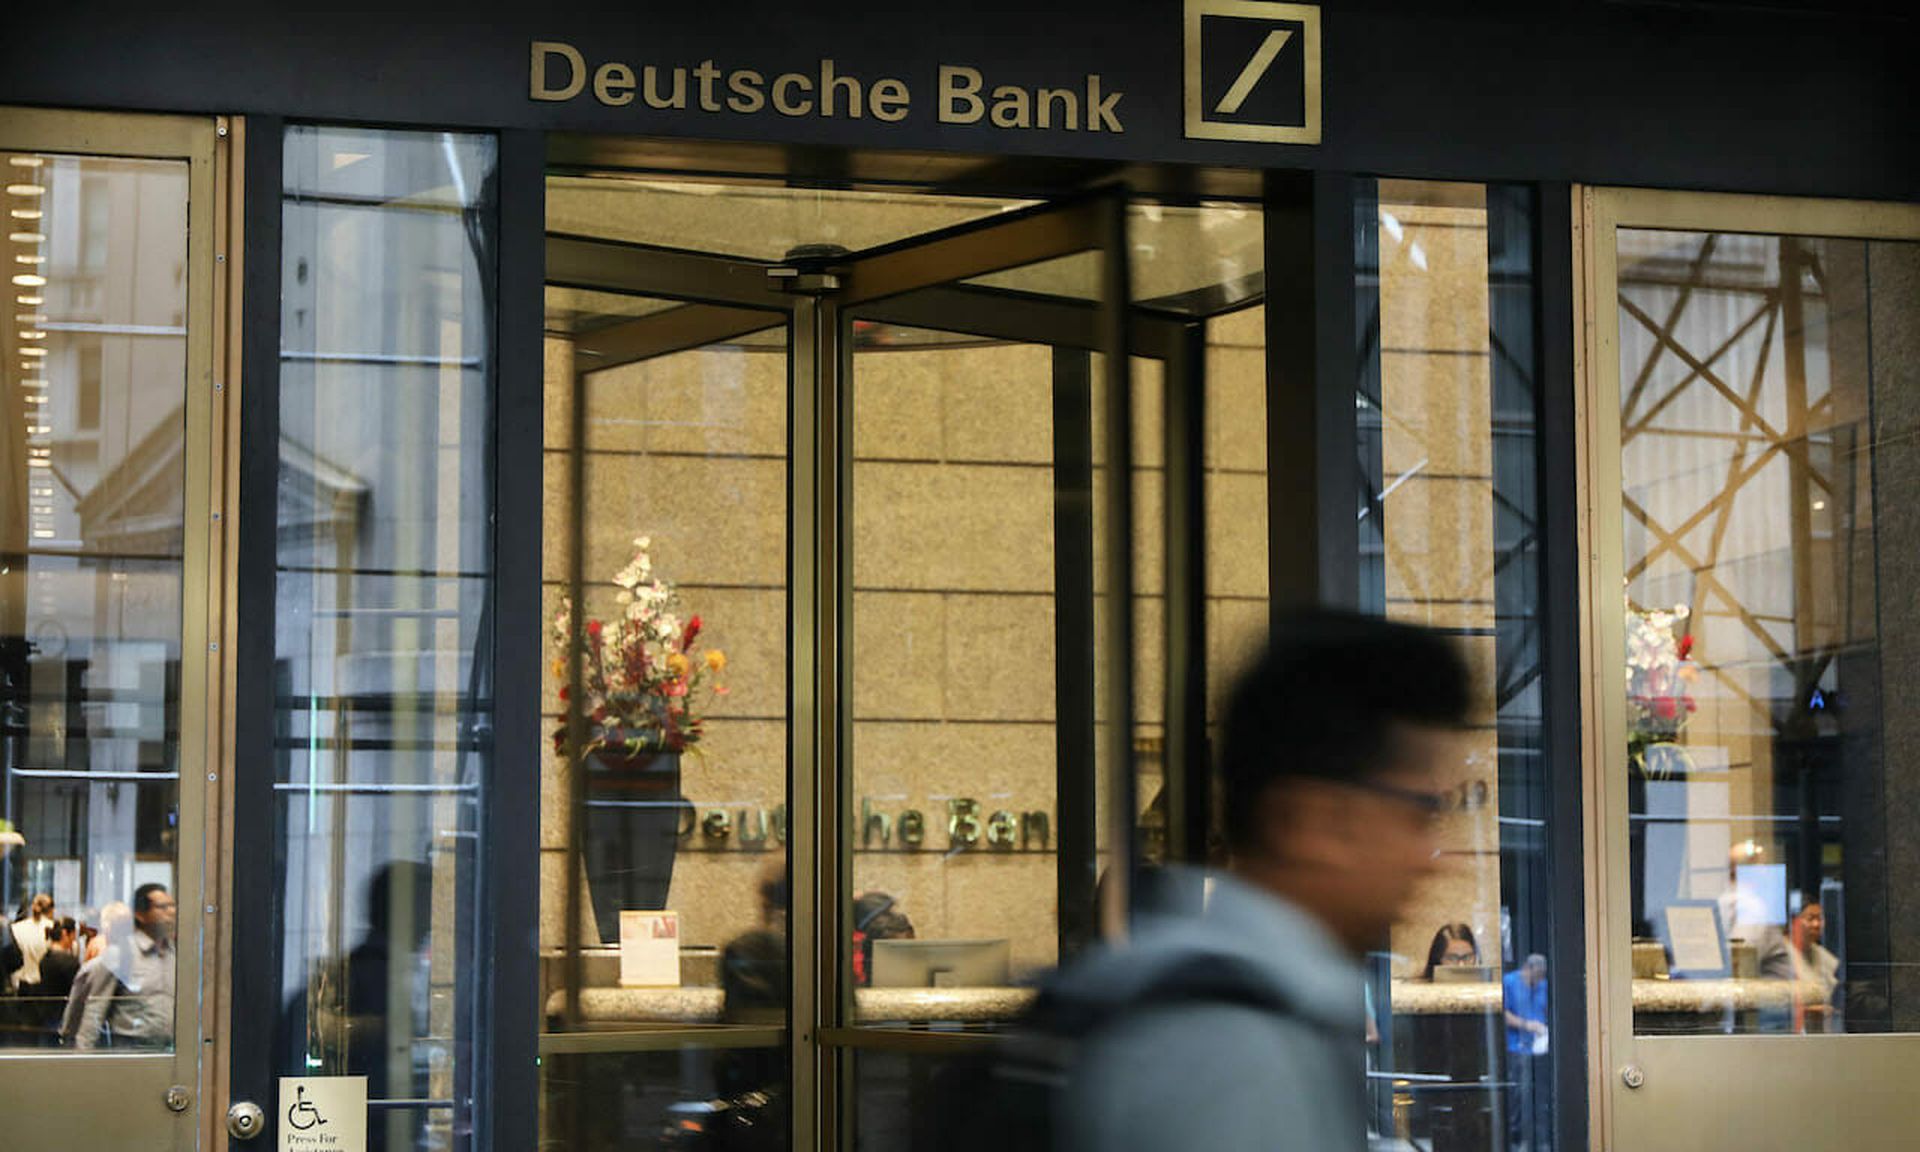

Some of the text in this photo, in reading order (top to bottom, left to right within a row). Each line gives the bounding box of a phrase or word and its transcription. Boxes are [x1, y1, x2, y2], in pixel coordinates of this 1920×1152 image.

[530, 41, 1125, 133] Deutsche Bank
[676, 797, 1050, 847] Deuthe Ban
[287, 1133, 338, 1144] Press For
